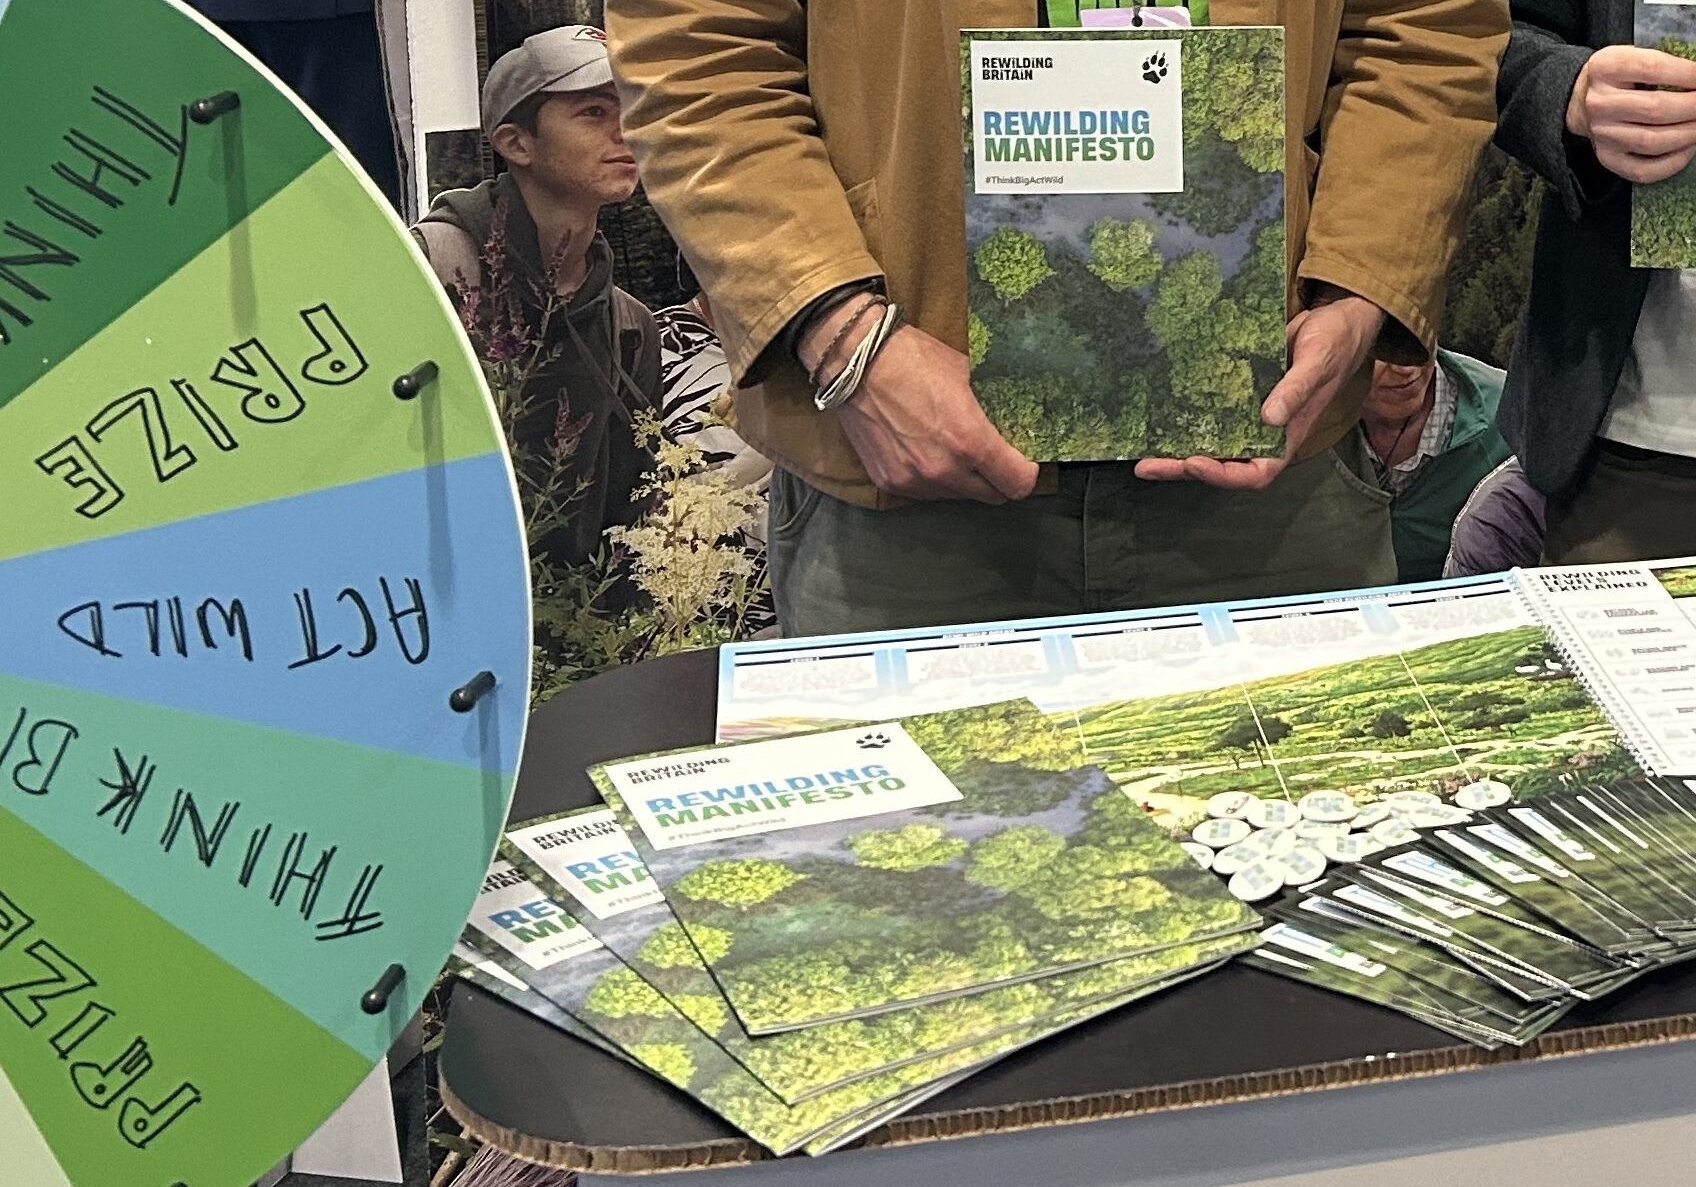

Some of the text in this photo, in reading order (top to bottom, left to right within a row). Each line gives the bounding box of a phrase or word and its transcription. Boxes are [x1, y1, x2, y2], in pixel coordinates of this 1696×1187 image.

[984, 110, 1150, 136] REWILDING
[984, 136, 1155, 162] MANIFESTO
[985, 176, 1064, 186] #ThinkBigActWild
[34, 302, 369, 518] PRIZE
[57, 575, 432, 669] ACT WILD
[645, 763, 892, 813] REWILDING
[654, 777, 907, 828] MANIFESTO
[96, 747, 384, 941] THINK
